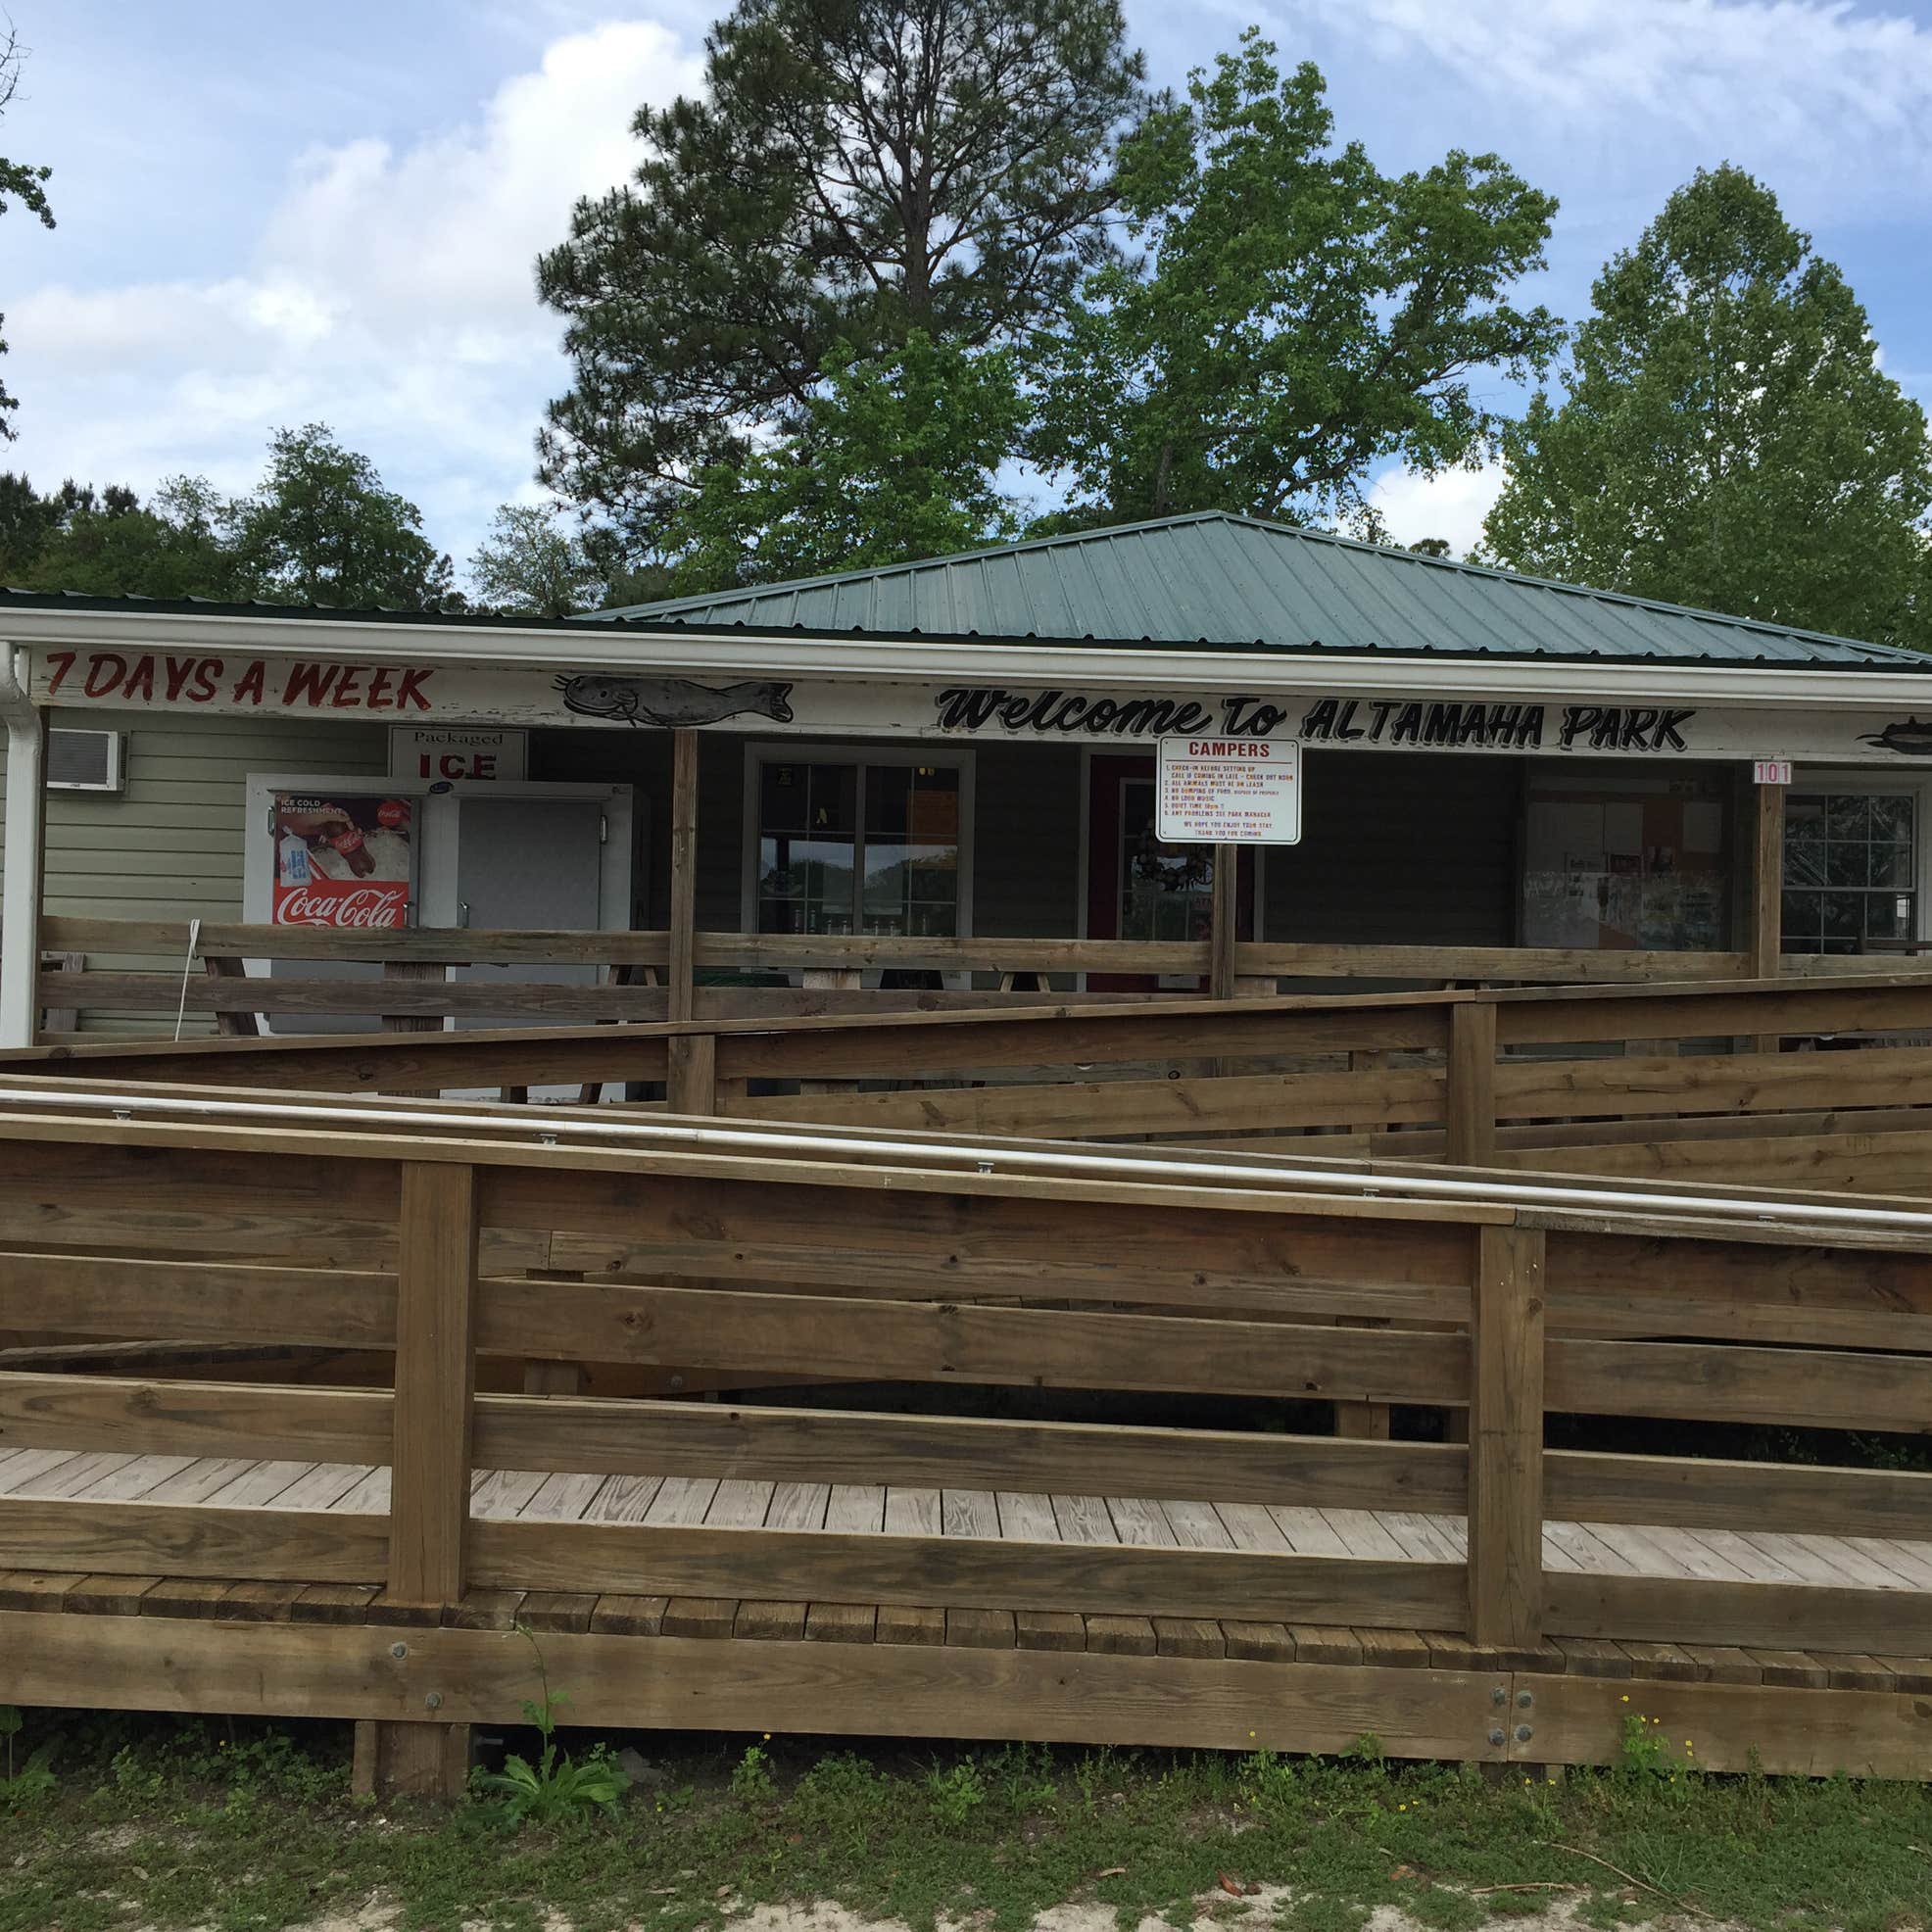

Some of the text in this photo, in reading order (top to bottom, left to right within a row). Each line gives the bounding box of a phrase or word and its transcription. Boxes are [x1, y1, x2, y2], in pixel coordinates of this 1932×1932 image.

[46, 652, 438, 711] 7 DAYS A WEEK
[934, 688, 1212, 738] Welcome
[1298, 699, 1548, 749] ALTAMAHA
[1559, 705, 1698, 752] PARK
[413, 731, 504, 747] Packaged
[1189, 742, 1270, 757] CAMPERS
[419, 753, 497, 780] ICE
[1758, 763, 1788, 782] 101
[277, 887, 406, 927] Coca-Cola
